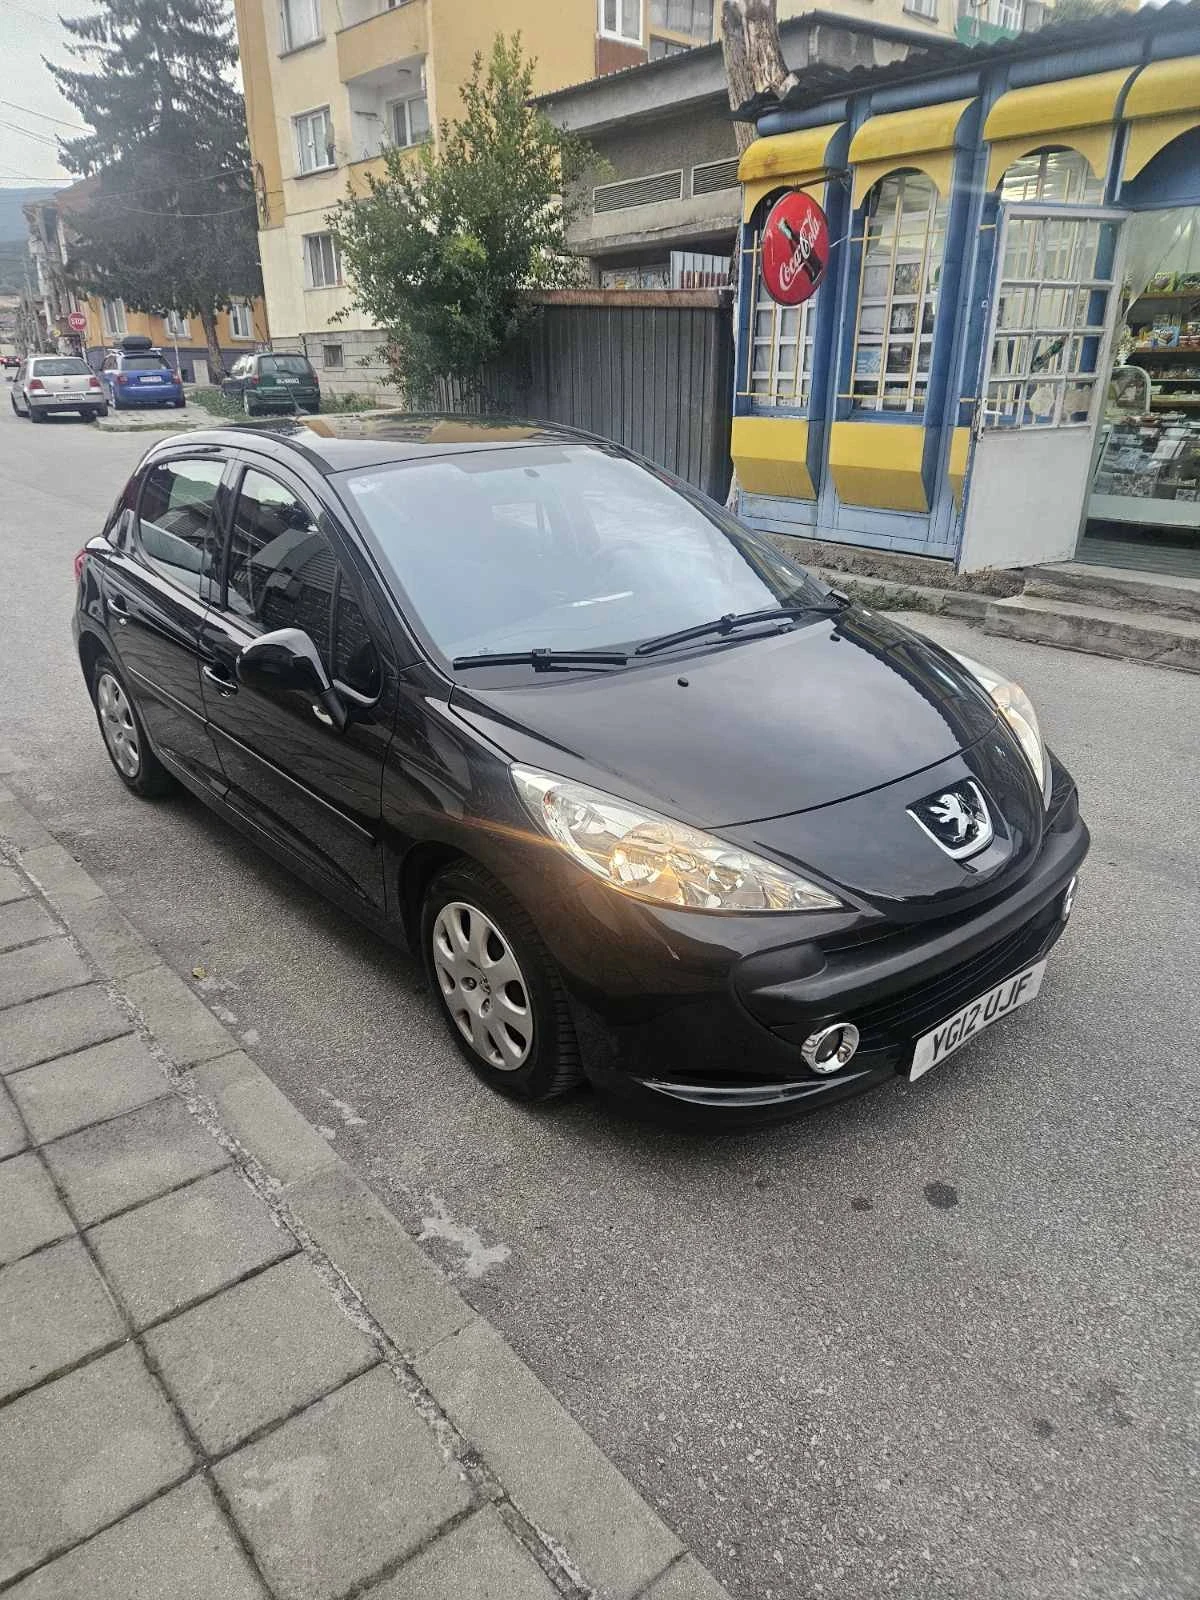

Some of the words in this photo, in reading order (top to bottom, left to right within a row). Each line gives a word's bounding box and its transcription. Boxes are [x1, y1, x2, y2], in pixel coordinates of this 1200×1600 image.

[70, 317, 86, 326] STOP
[932, 1003, 982, 1062] YG12
[983, 971, 1033, 1022] UJF
